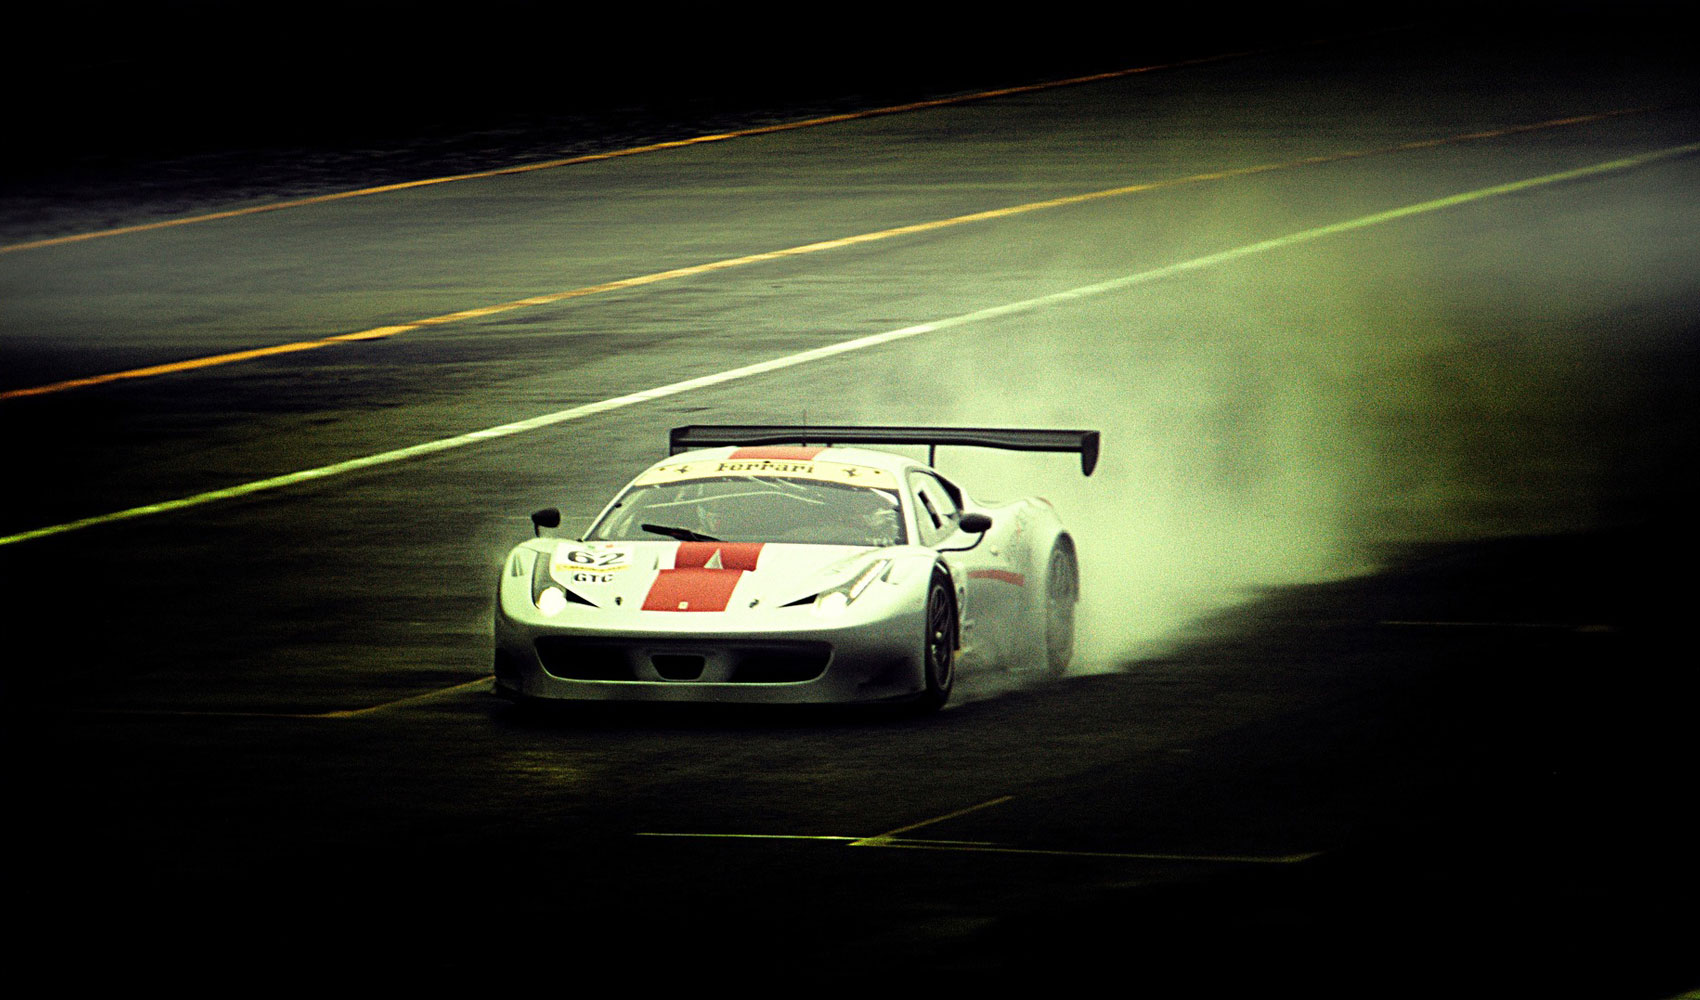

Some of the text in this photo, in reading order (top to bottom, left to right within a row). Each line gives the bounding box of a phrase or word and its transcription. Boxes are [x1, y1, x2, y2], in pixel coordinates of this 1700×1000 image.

[717, 461, 814, 474] Ferrari
[567, 551, 625, 566] 62
[573, 573, 614, 583] GTC
